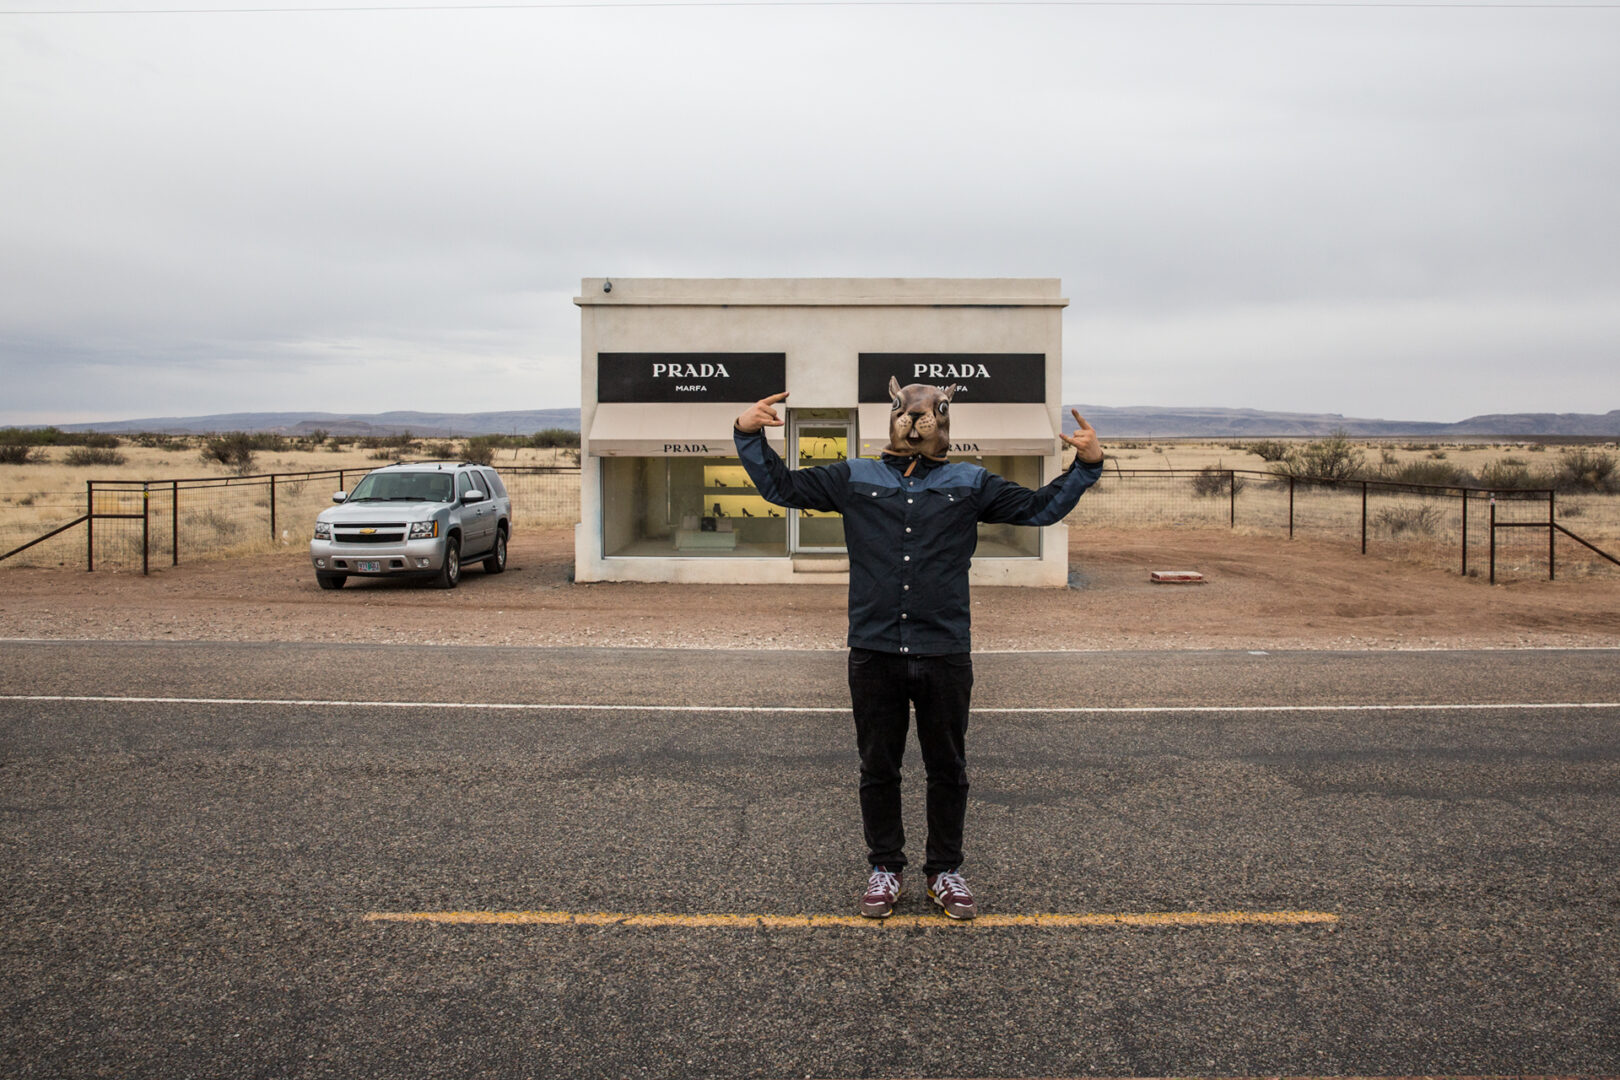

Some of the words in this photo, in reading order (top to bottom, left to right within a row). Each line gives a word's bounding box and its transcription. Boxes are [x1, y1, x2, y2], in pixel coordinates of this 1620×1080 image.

[652, 363, 730, 378] PRADA
[913, 363, 991, 378] PRADA
[663, 444, 709, 453] PRADA
[947, 443, 980, 452] RADA
